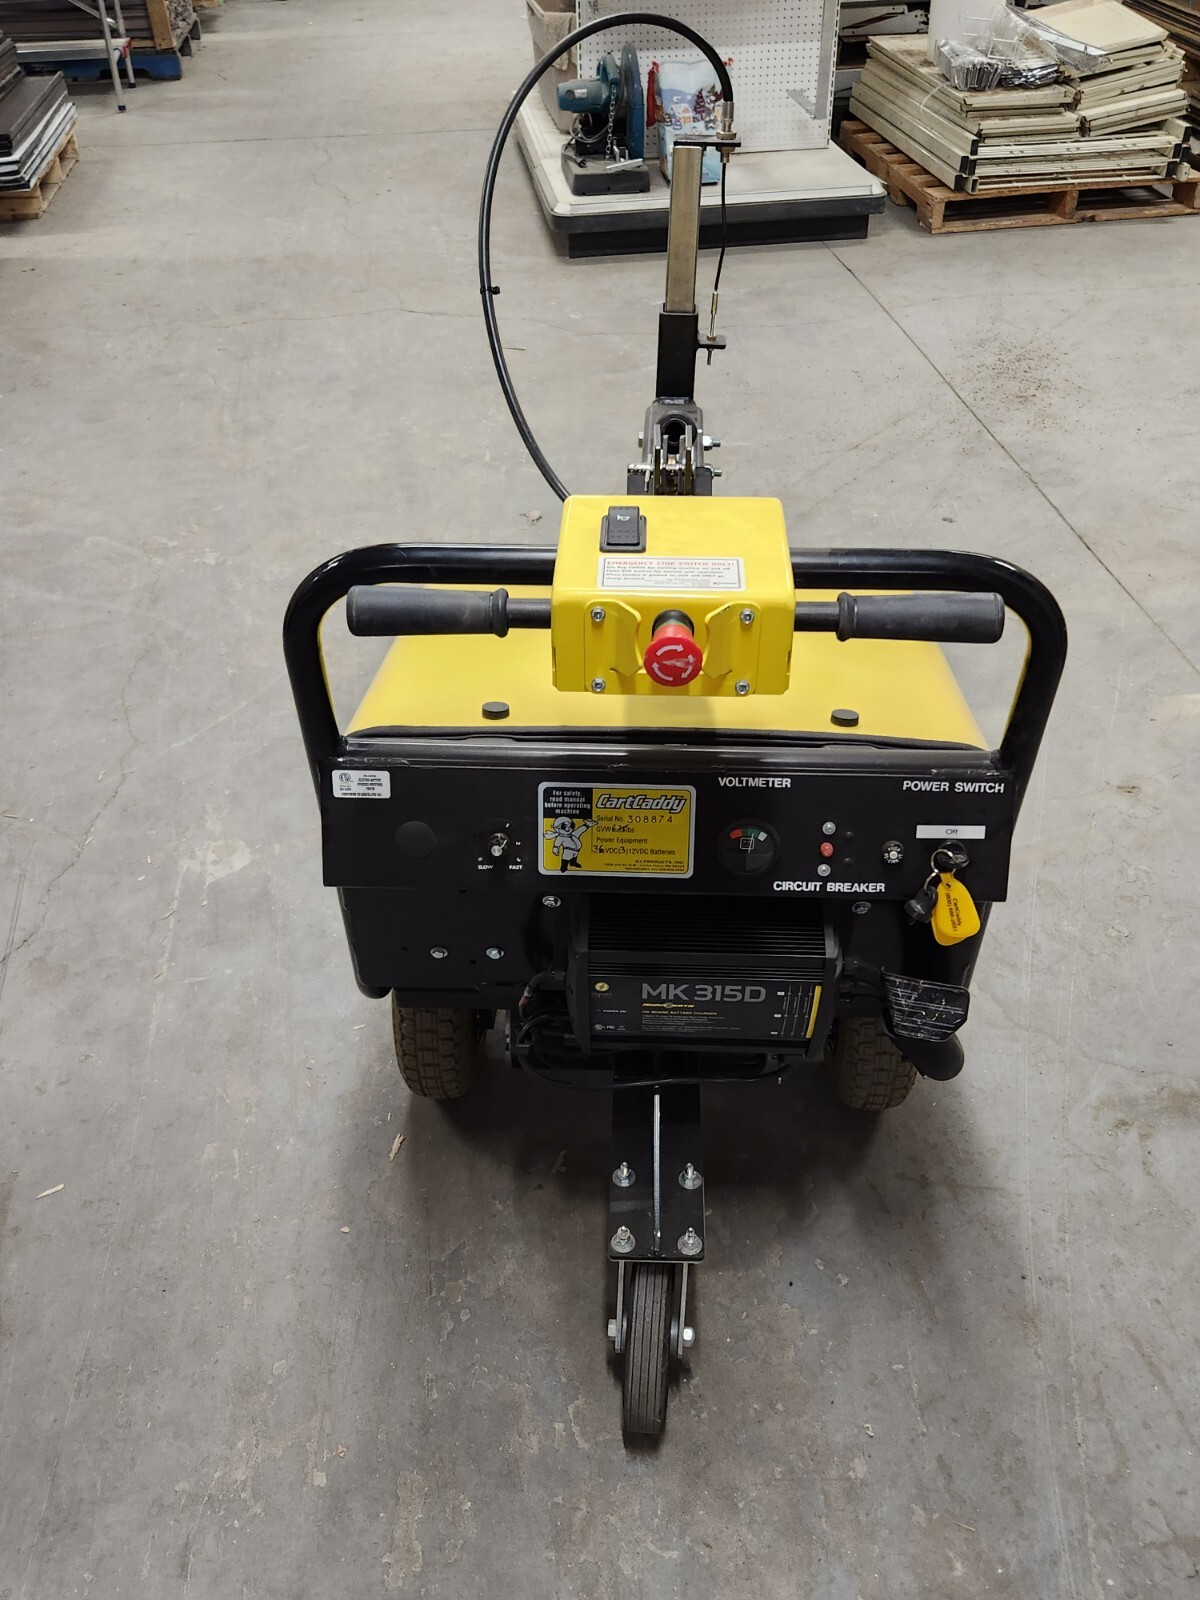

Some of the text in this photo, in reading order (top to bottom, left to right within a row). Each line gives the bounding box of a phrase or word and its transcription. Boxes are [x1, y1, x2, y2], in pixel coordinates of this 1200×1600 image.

[718, 776, 792, 788] VOLTMETER
[902, 780, 1005, 793] POWER SWITCH
[596, 794, 687, 814] CartCaddy
[627, 815, 672, 823] 308874
[773, 881, 886, 892] CIRCUIT BREAKER
[642, 983, 766, 1002] MK 315D
